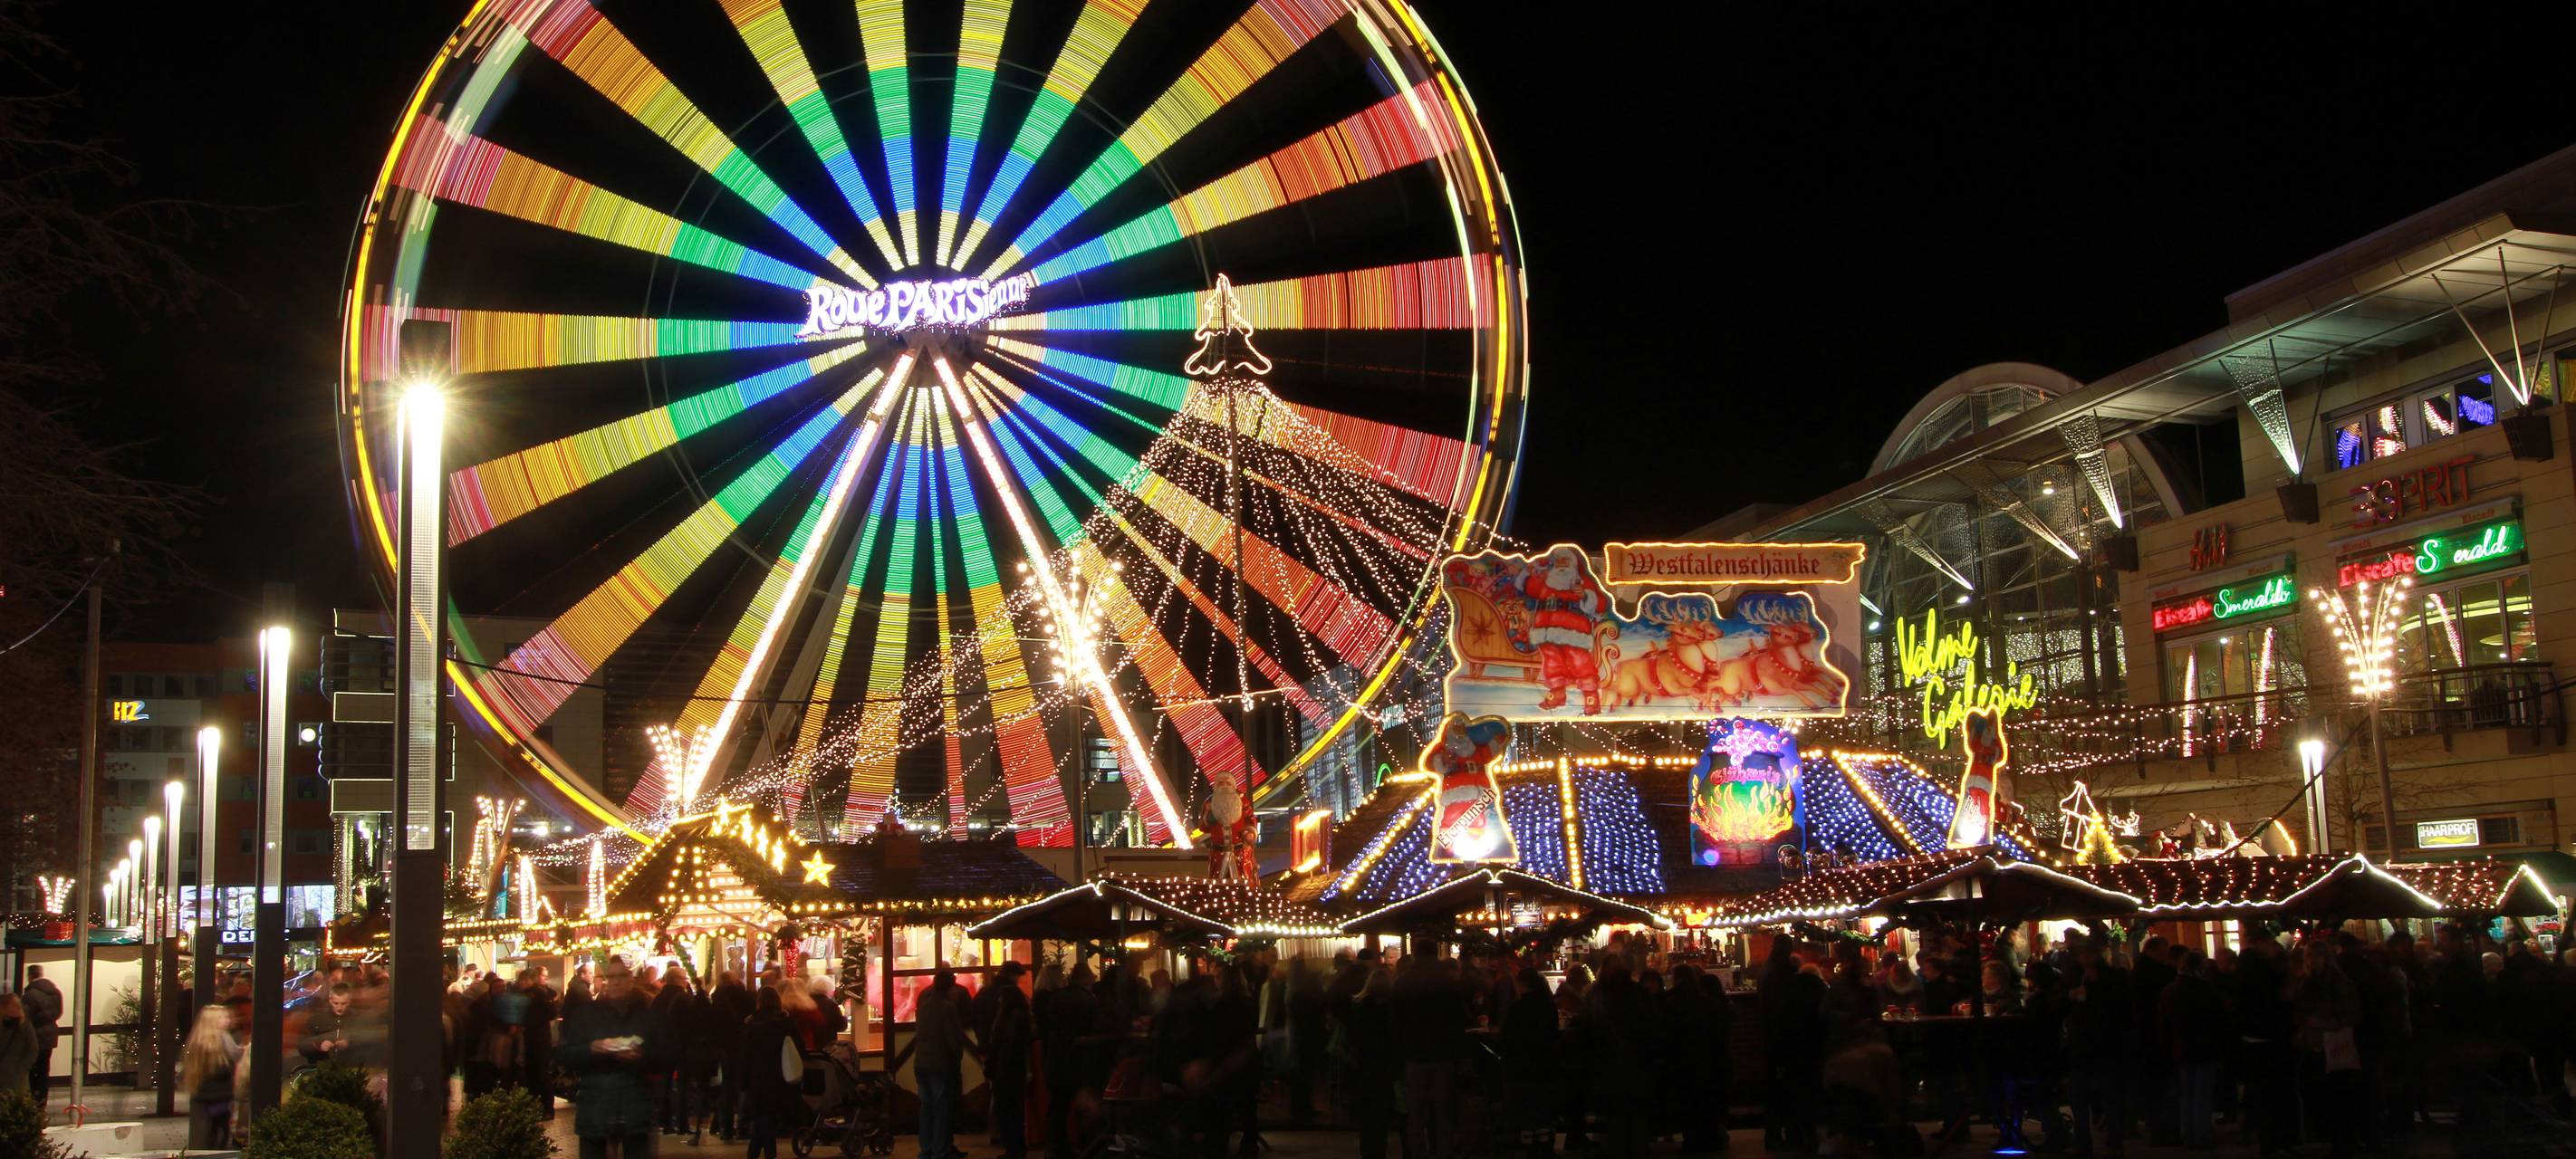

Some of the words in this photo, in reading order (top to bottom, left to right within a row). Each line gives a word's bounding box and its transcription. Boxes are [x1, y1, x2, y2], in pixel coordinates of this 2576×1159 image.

[2350, 454, 2475, 529] ESPRIT
[1629, 552, 1821, 580] Westfalenschänke
[1897, 608, 1978, 688] Volme
[1436, 787, 1497, 849] Eierpunsch
